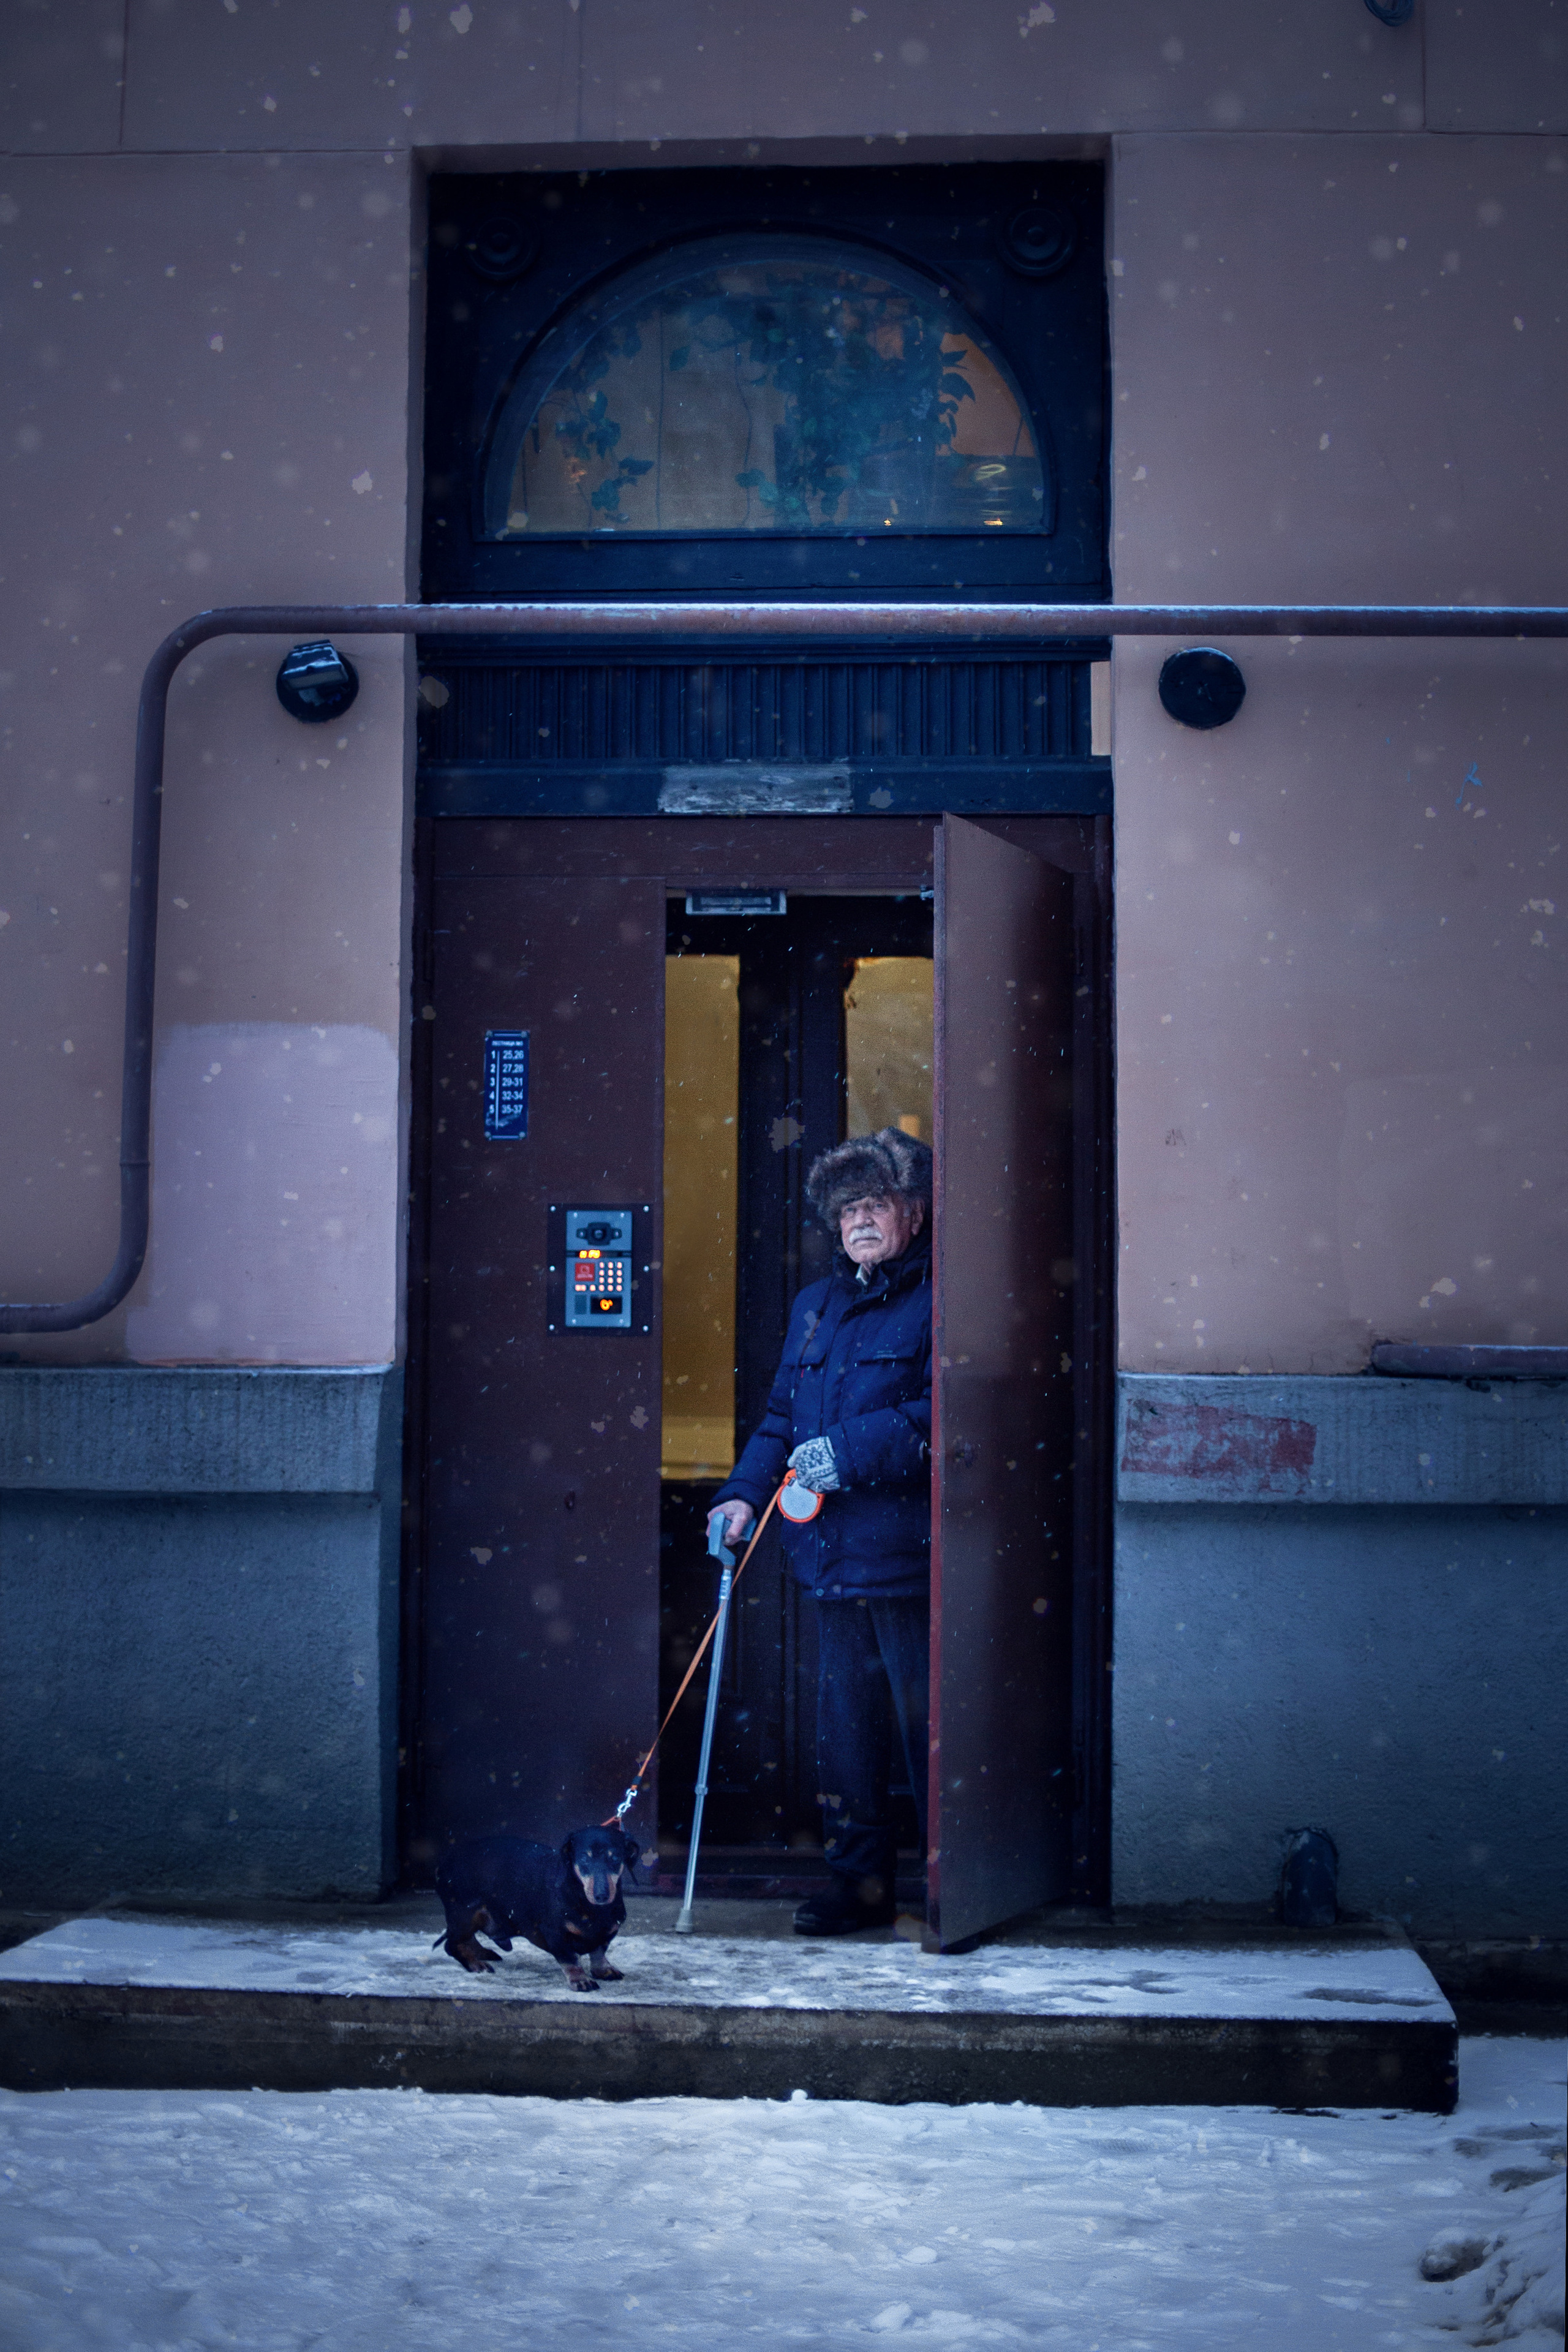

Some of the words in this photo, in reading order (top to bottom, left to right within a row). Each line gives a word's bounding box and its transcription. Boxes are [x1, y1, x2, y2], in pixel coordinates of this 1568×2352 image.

[491, 1050, 496, 1059] 1
[502, 1050, 524, 1060] 25,26
[490, 1064, 496, 1073] 2
[502, 1064, 524, 1073] 27,28
[490, 1077, 496, 1087] 3
[502, 1077, 523, 1087] 29-31
[489, 1091, 495, 1100] 4
[502, 1091, 523, 1101] 32-34
[489, 1104, 494, 1114] 5
[502, 1104, 523, 1114] 35-37
